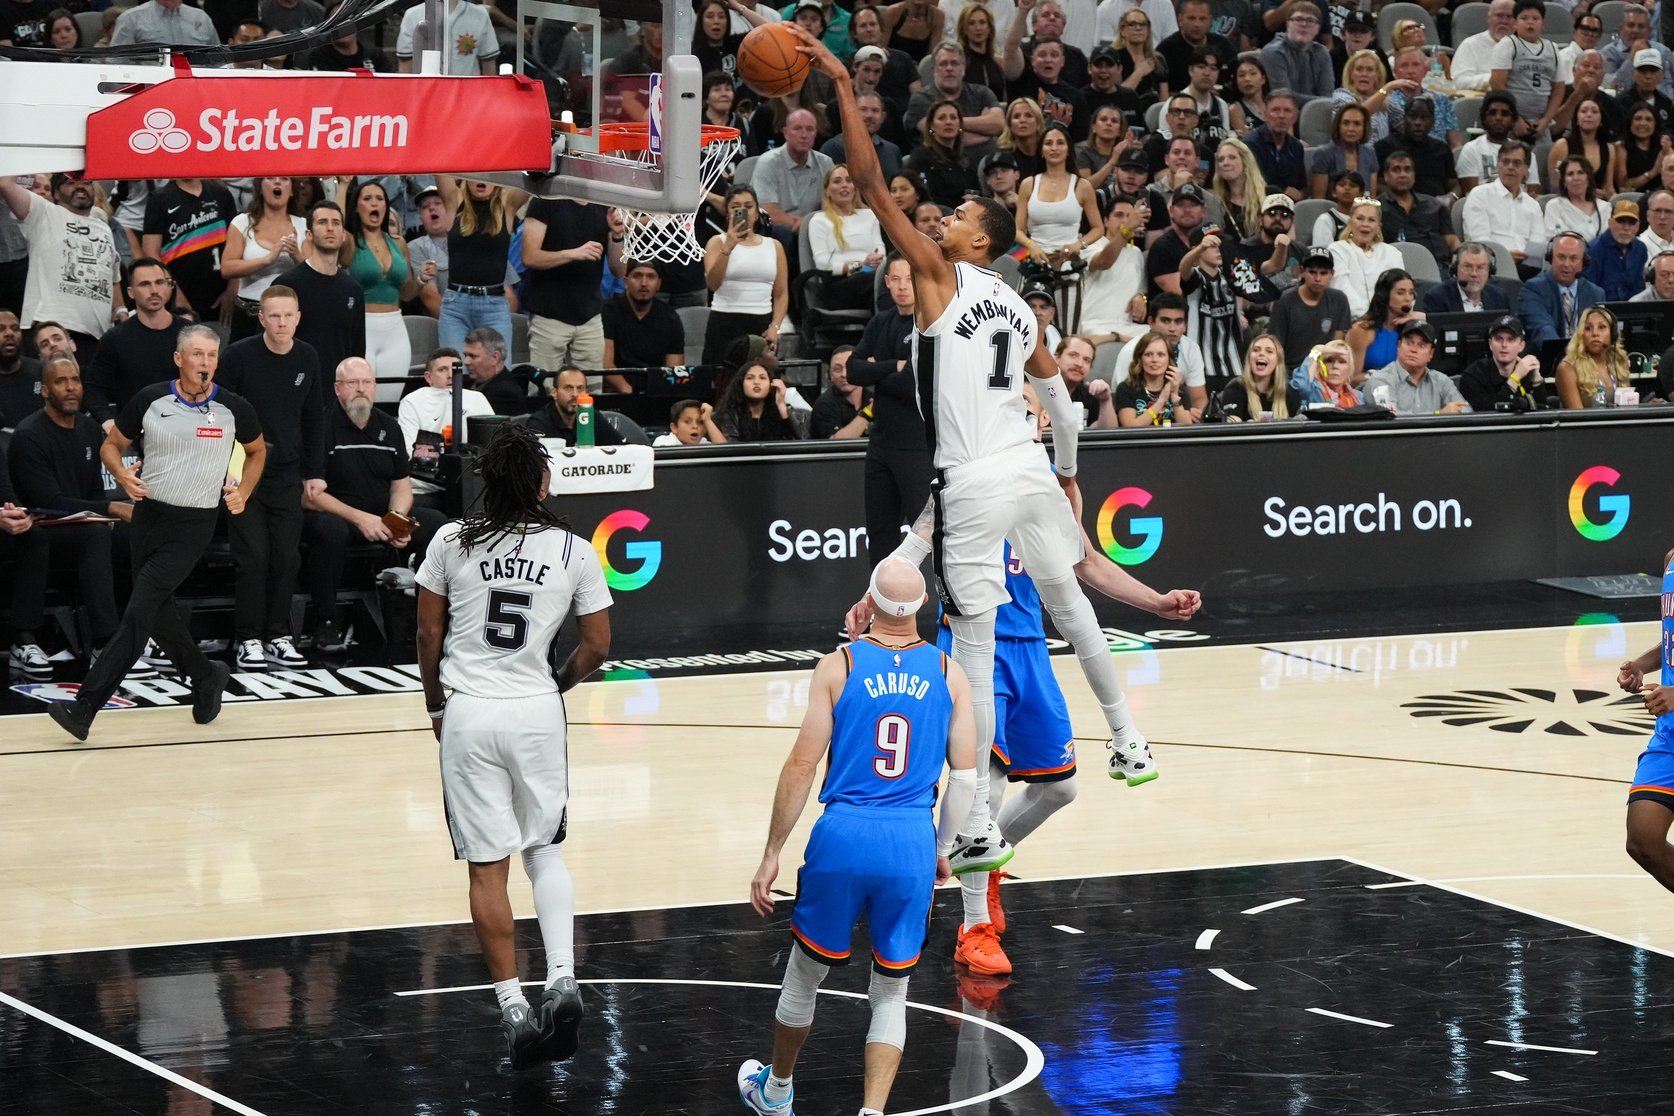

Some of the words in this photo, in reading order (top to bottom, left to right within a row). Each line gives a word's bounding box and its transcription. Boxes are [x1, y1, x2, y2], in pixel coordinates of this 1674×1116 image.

[1532, 73, 1541, 87] 5
[987, 329, 1013, 391] 1
[197, 429, 223, 437] Emirates
[578, 412, 589, 425] G
[561, 464, 632, 478] GATORADE
[1097, 487, 1164, 565] G
[1263, 492, 1401, 538] Search
[1412, 499, 1473, 529] on.
[1568, 466, 1631, 541] G
[480, 558, 550, 586] CASTLE
[592, 510, 662, 591] G
[483, 587, 533, 653] 5
[863, 672, 931, 701] CARUSO
[872, 713, 912, 781] 9
